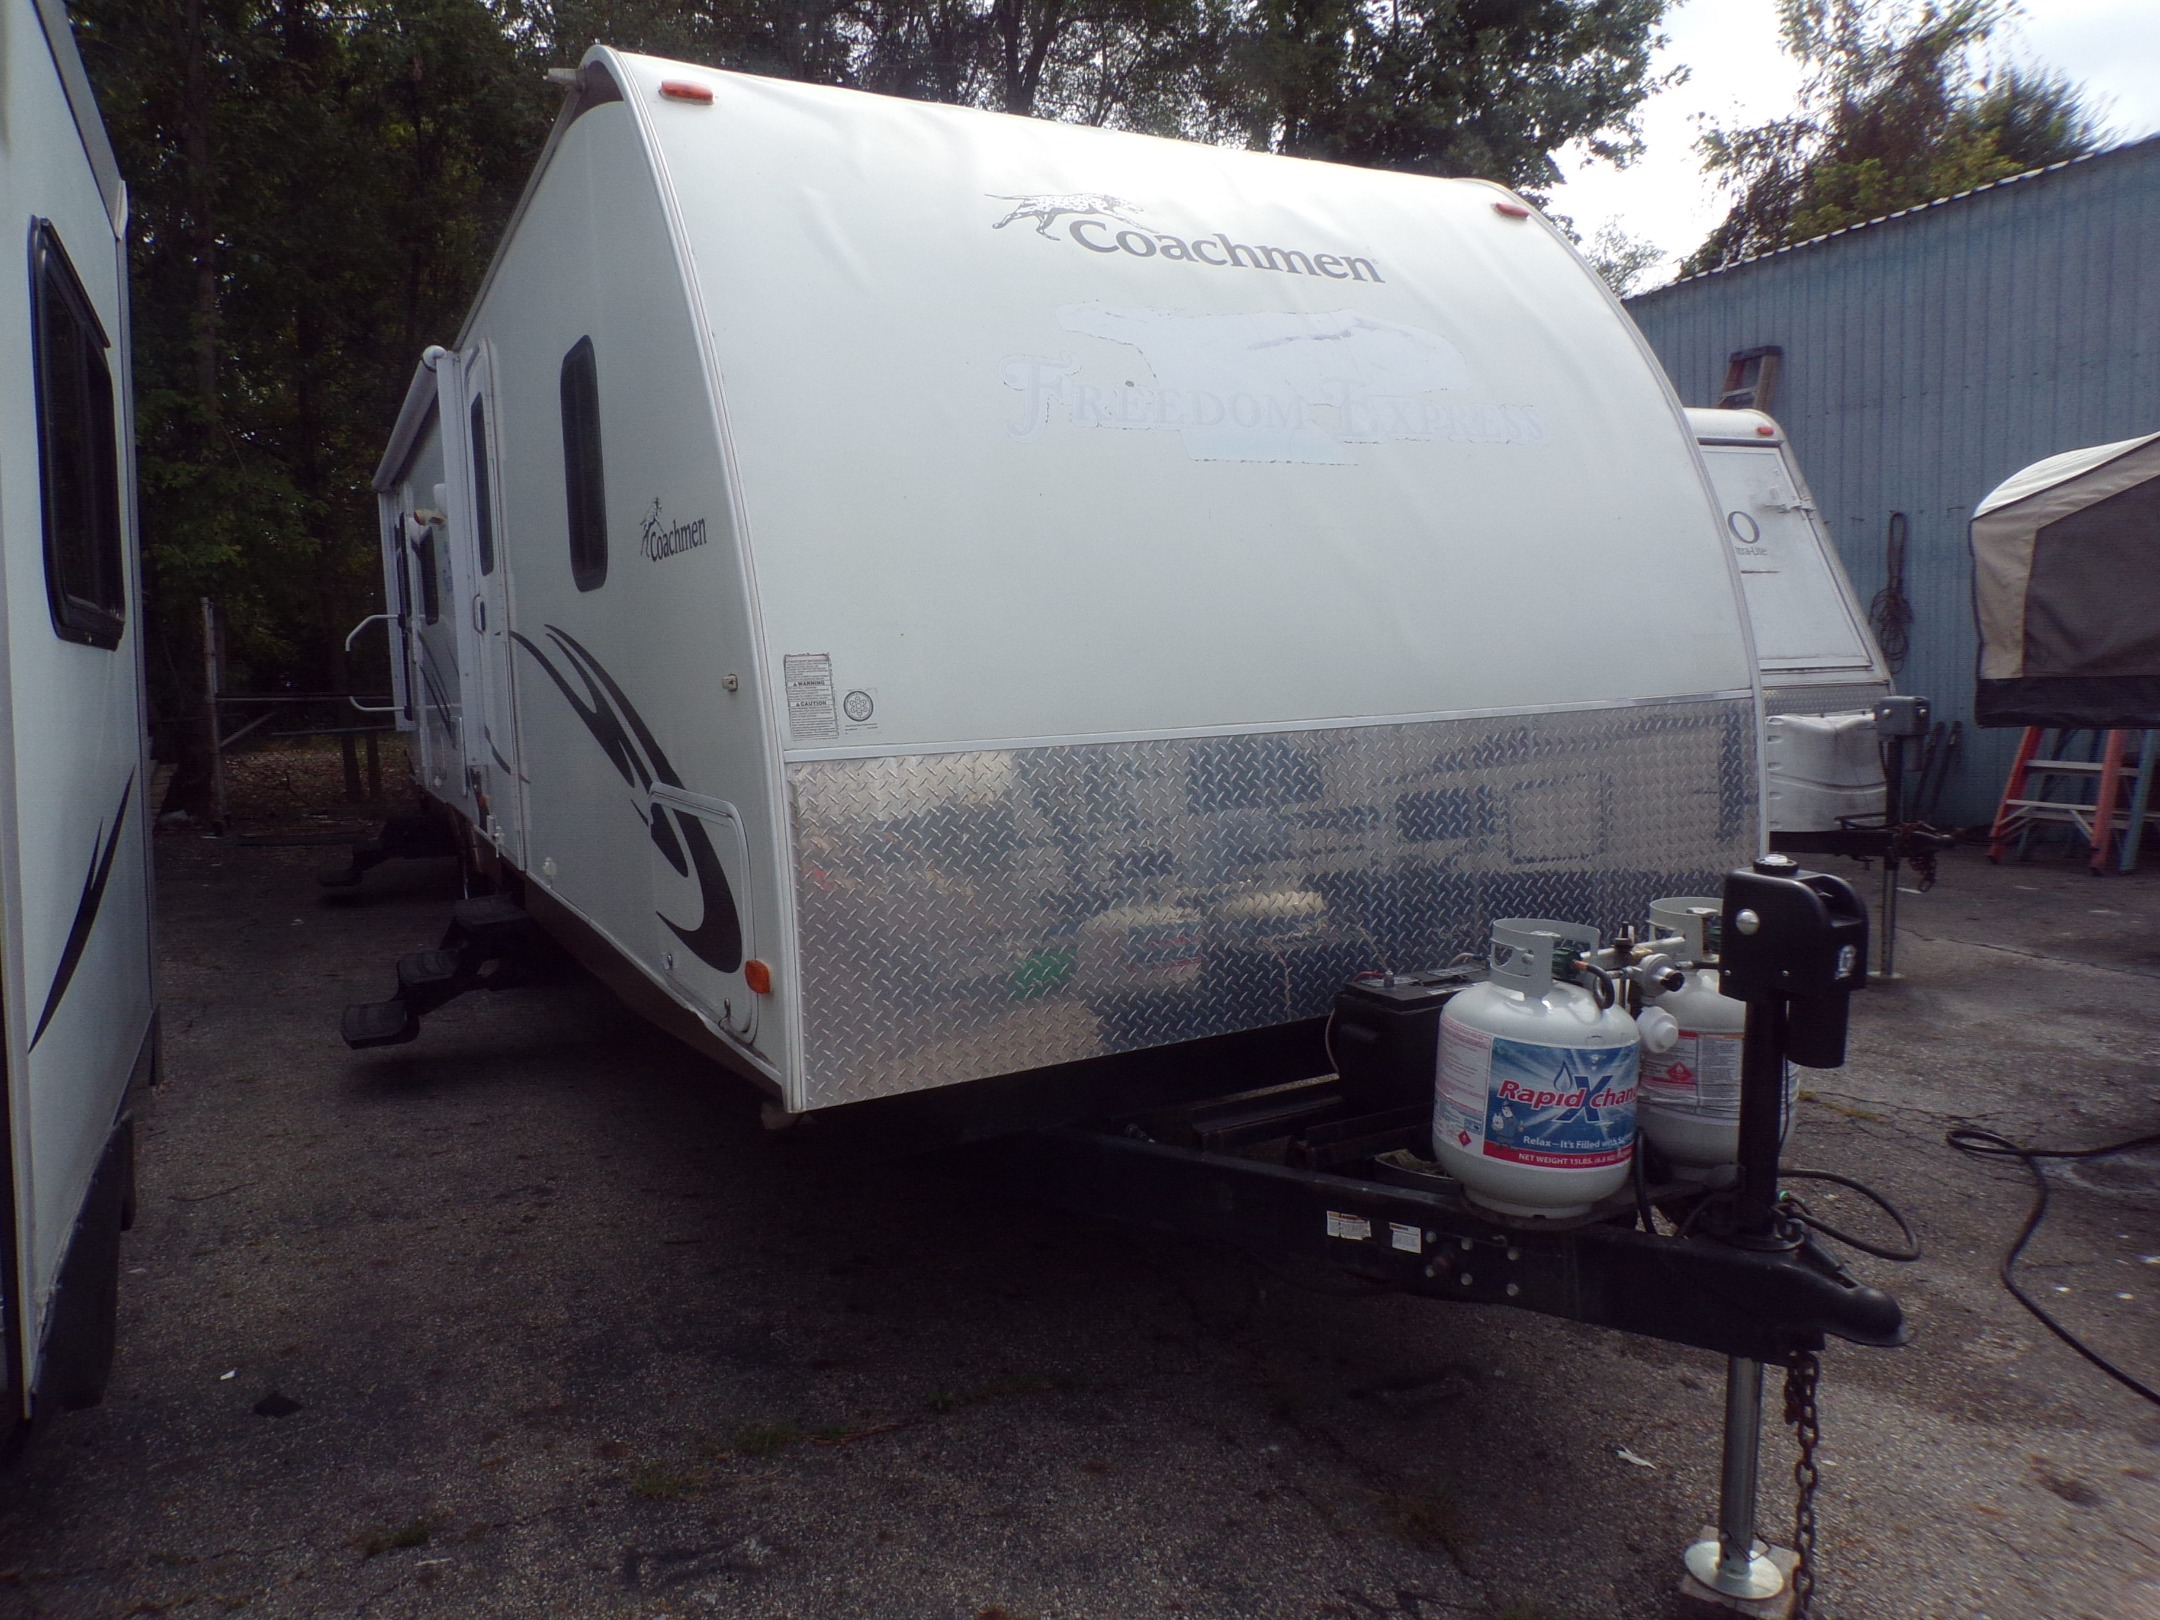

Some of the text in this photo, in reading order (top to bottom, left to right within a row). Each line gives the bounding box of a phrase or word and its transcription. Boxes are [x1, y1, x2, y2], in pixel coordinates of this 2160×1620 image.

[1069, 219, 1385, 284] Coachmen
[649, 517, 708, 562] Coachmen
[1575, 1139, 1601, 1149] Filled
[1518, 1153, 1535, 1161] NET
[1536, 1156, 1568, 1164] WEIGHT
